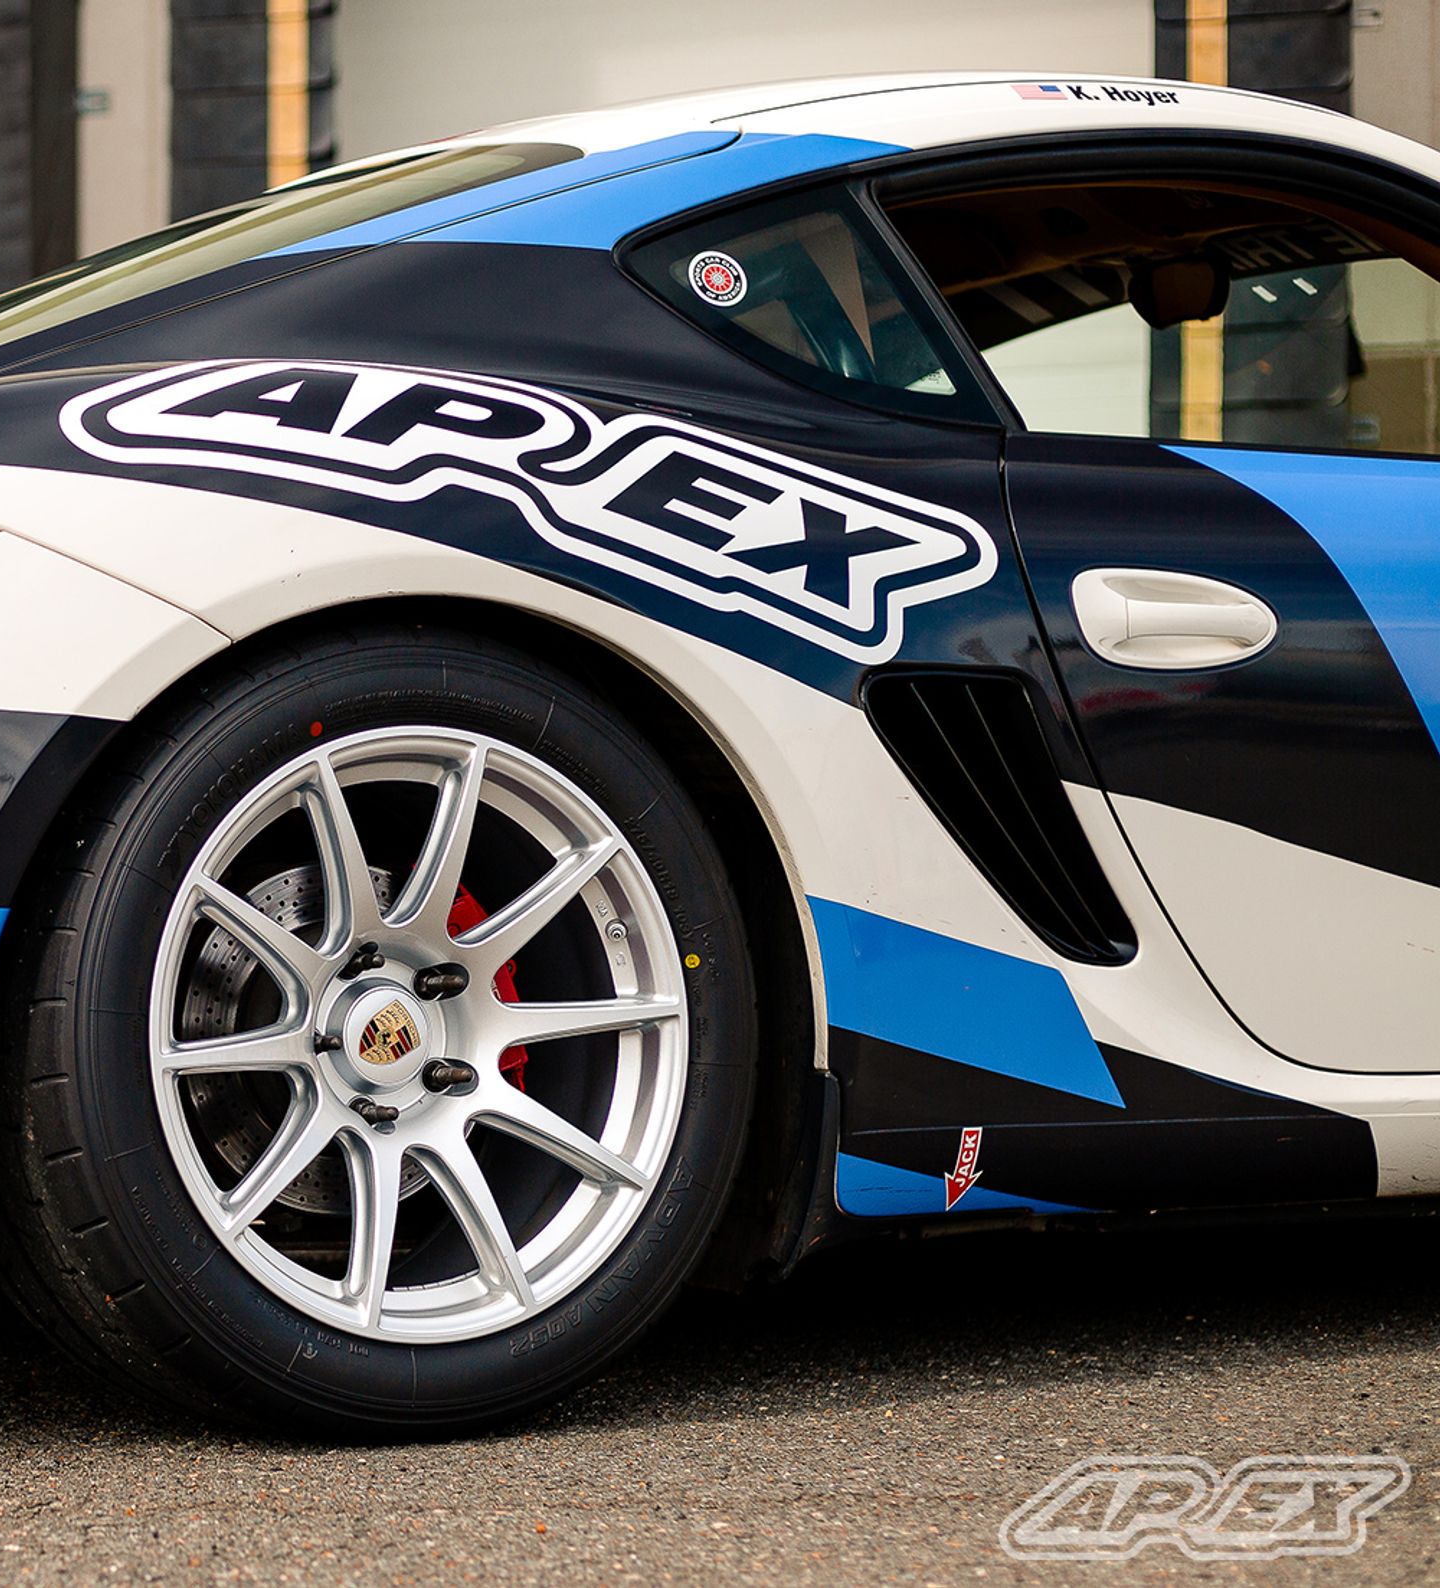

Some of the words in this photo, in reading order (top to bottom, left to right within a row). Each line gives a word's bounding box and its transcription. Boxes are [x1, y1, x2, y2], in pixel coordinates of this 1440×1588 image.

[1066, 85, 1100, 100] K.
[1101, 85, 1180, 107] Hoyer
[135, 364, 945, 624] APEX
[954, 1133, 978, 1188] JACK
[585, 1155, 694, 1313] ADVAN
[509, 1302, 584, 1358] A052
